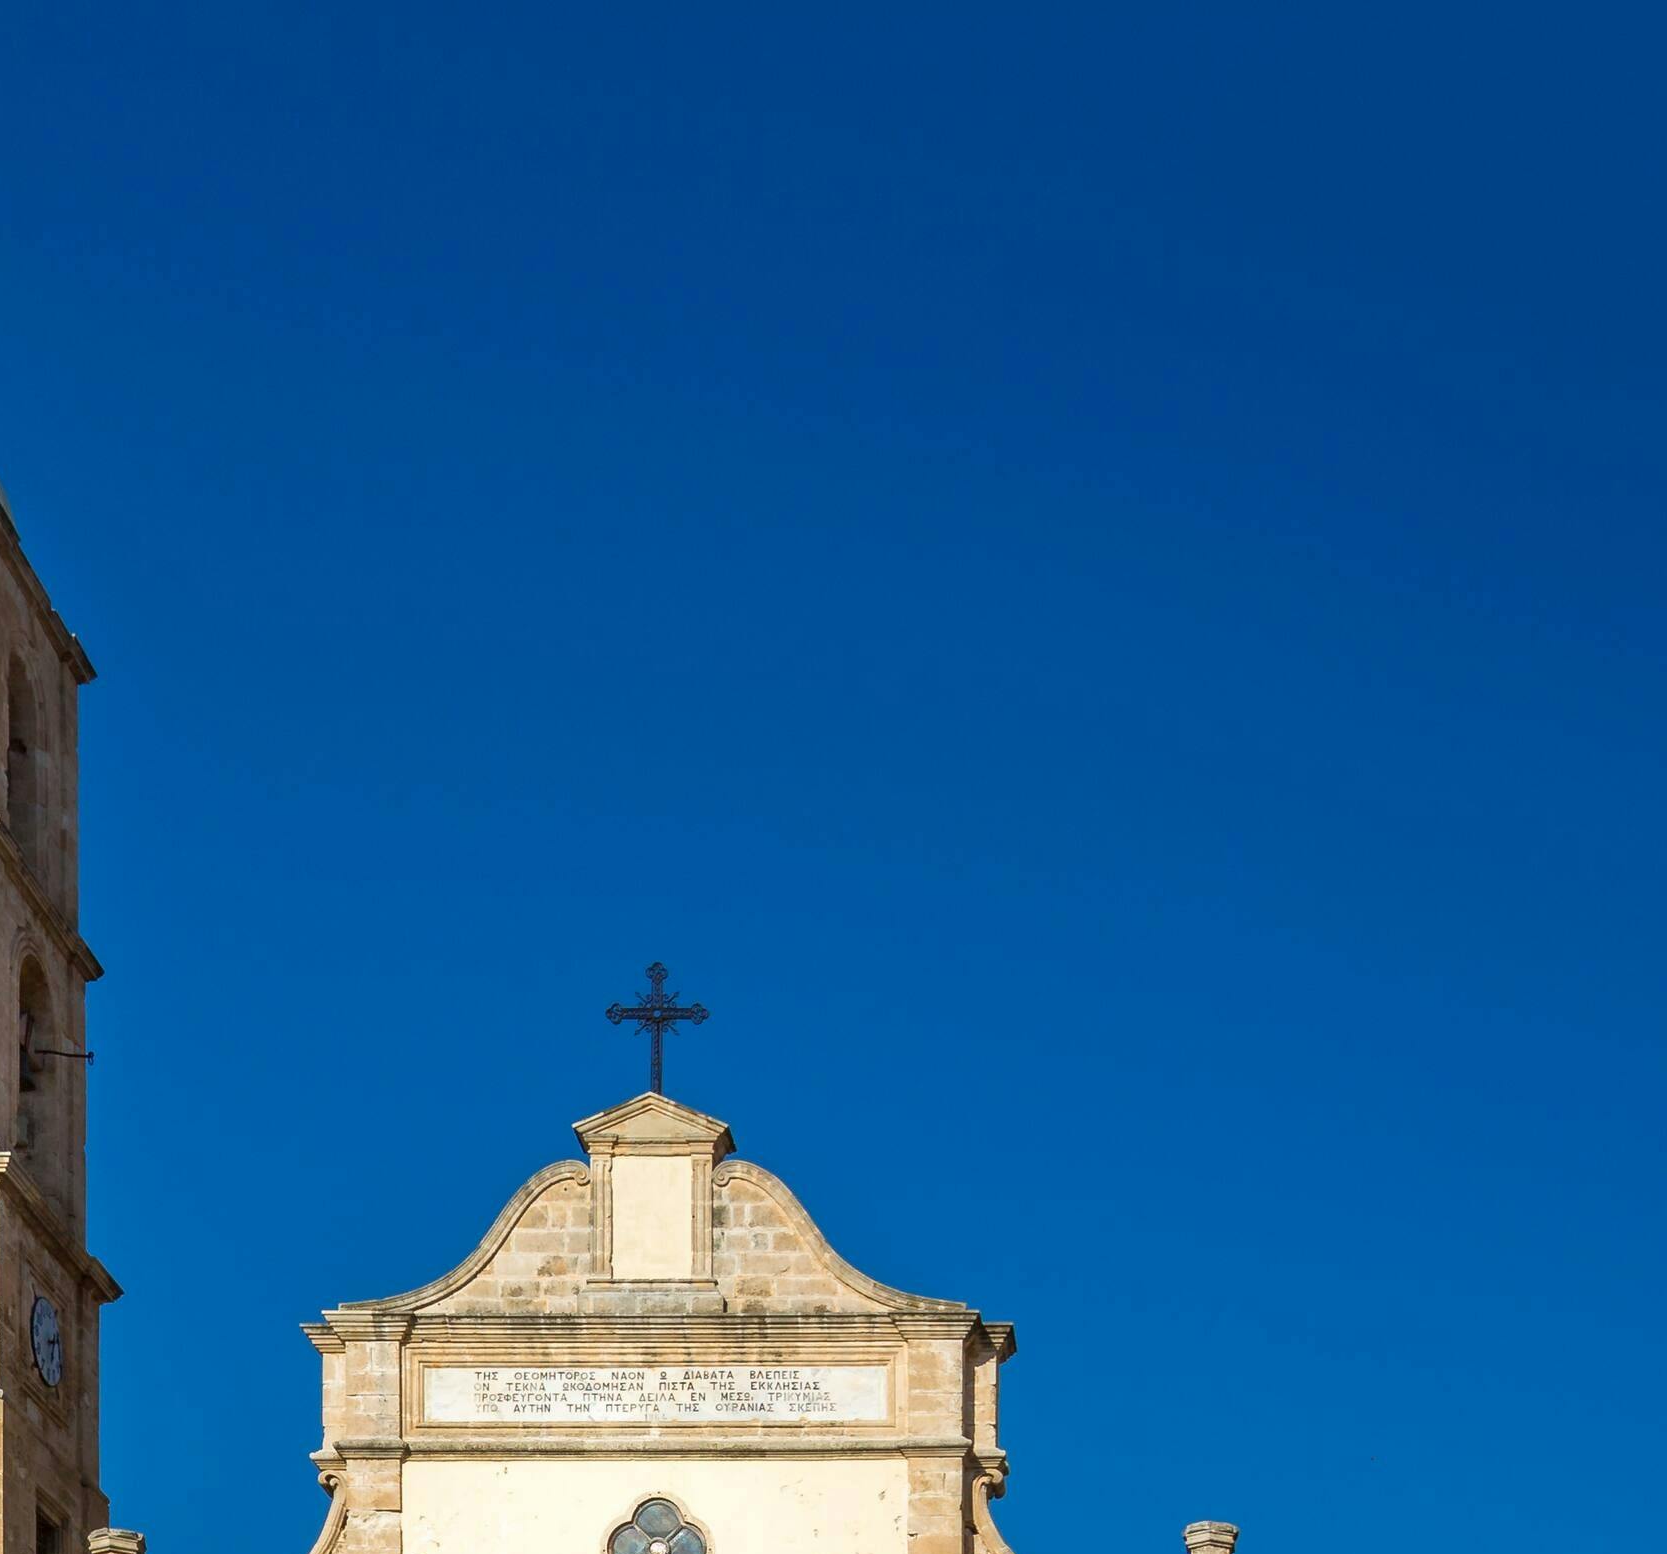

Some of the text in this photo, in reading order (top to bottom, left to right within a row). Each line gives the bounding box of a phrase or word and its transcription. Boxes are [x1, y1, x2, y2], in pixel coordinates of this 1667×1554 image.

[474, 1371, 499, 1381] ΤΗΣ
[611, 1371, 645, 1381] ΝΑΟΝ
[683, 1370, 735, 1380] ΔΙΑΒΑΤΑ
[749, 1370, 800, 1380] ΒΛΕΠΕΙΣ
[505, 1382, 546, 1391] ΤΕΚΝΑ
[562, 1382, 644, 1391] ΩΚΟΔΟΜΗΣΑΝ
[659, 1382, 695, 1391] ΠΙΣΤΑ
[710, 1382, 736, 1391] ΤΗΣ
[750, 1381, 820, 1391] ΕΚΚΛΗΣΙΑΣ
[474, 1393, 568, 1402] ΠΡΟΣΦΕΥΓΟΝΤΑ
[582, 1393, 623, 1402] ΠΤΗΝΑ
[639, 1392, 676, 1402] ΔΕΙΛΑ
[690, 1392, 706, 1402] ΕΝ
[768, 1392, 830, 1402] ΤΡΙΚΥΜΙΑΣ
[475, 1403, 837, 1413] ΥΠΟ ΑΥΤΗΝ ΤΗΝ ΠΤΕΡΥΓΑ ΤΗΣ ΟΥΡΑΝΙΑΣ ΣΚΕΠΗΣ
